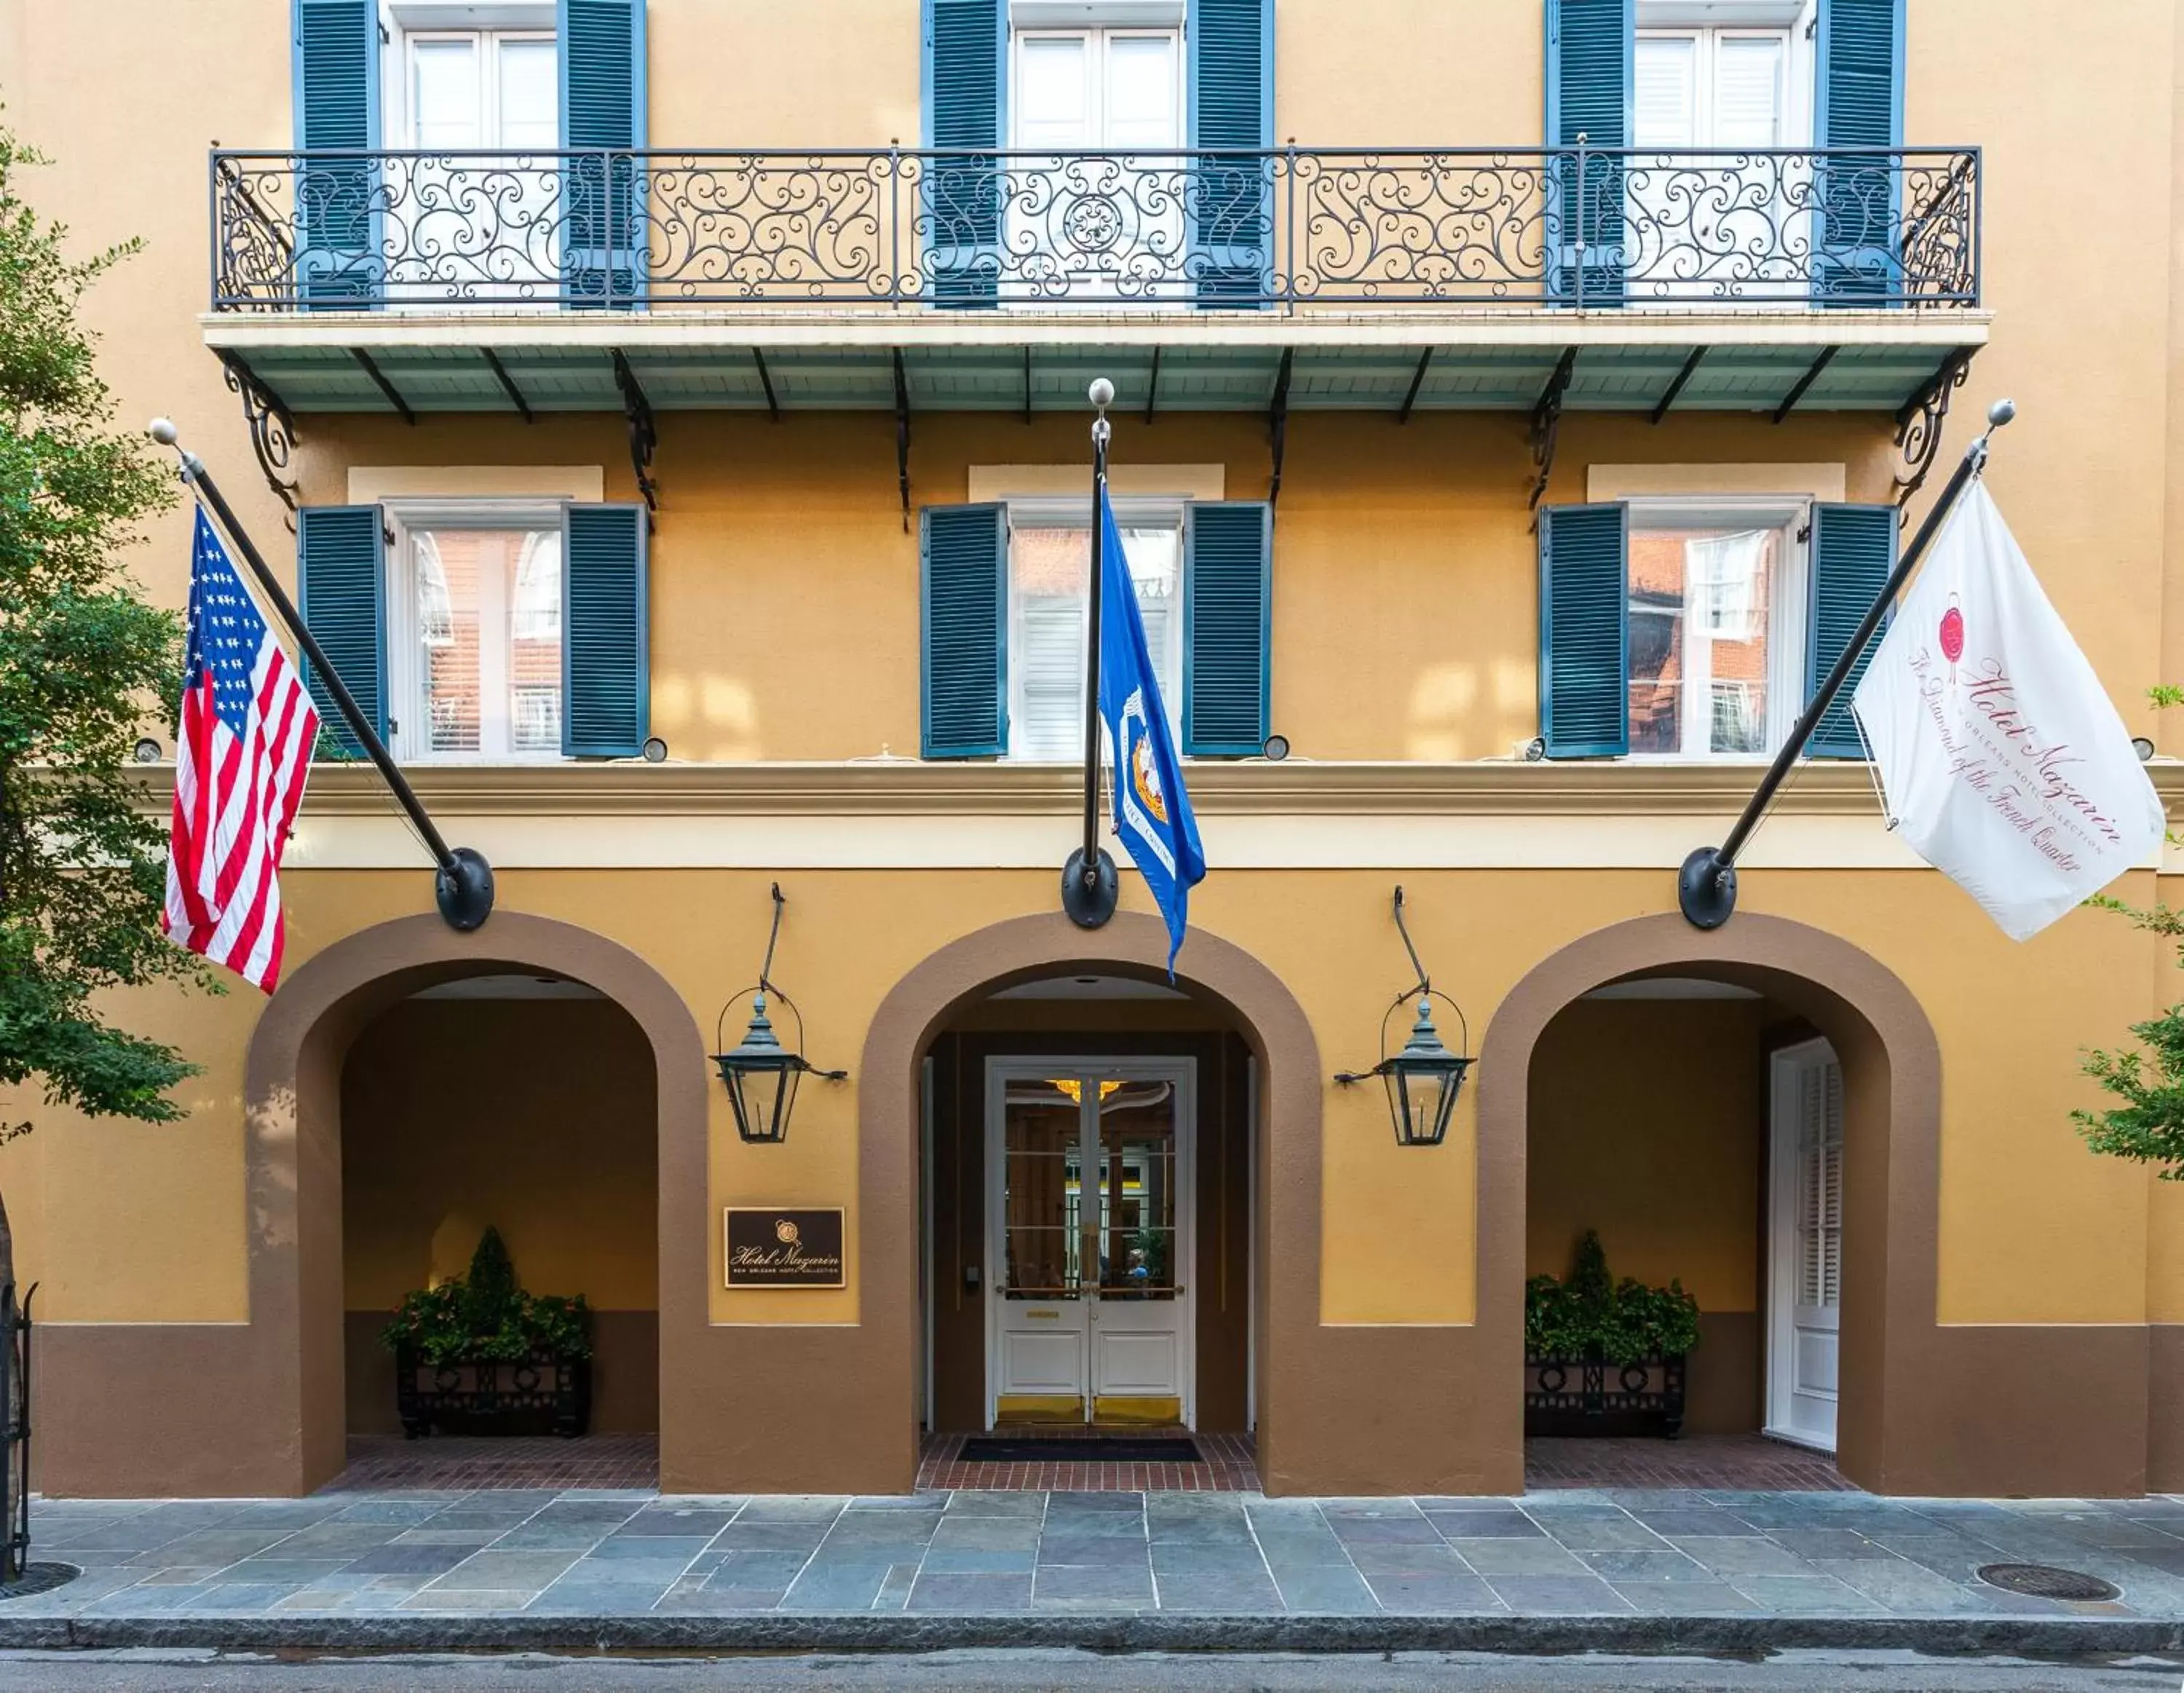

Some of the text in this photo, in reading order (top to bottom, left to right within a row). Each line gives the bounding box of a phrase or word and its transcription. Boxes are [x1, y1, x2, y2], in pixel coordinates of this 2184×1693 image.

[1920, 676, 1969, 756] Diamond
[1947, 758, 1987, 776] of
[1960, 657, 2121, 844] Hotel Mazarin
[1965, 769, 1998, 793] the
[1987, 784, 2043, 833] French
[2042, 798, 2103, 855] COLLECTION
[2030, 826, 2081, 871] Quarter
[730, 1245, 780, 1266] Hotel
